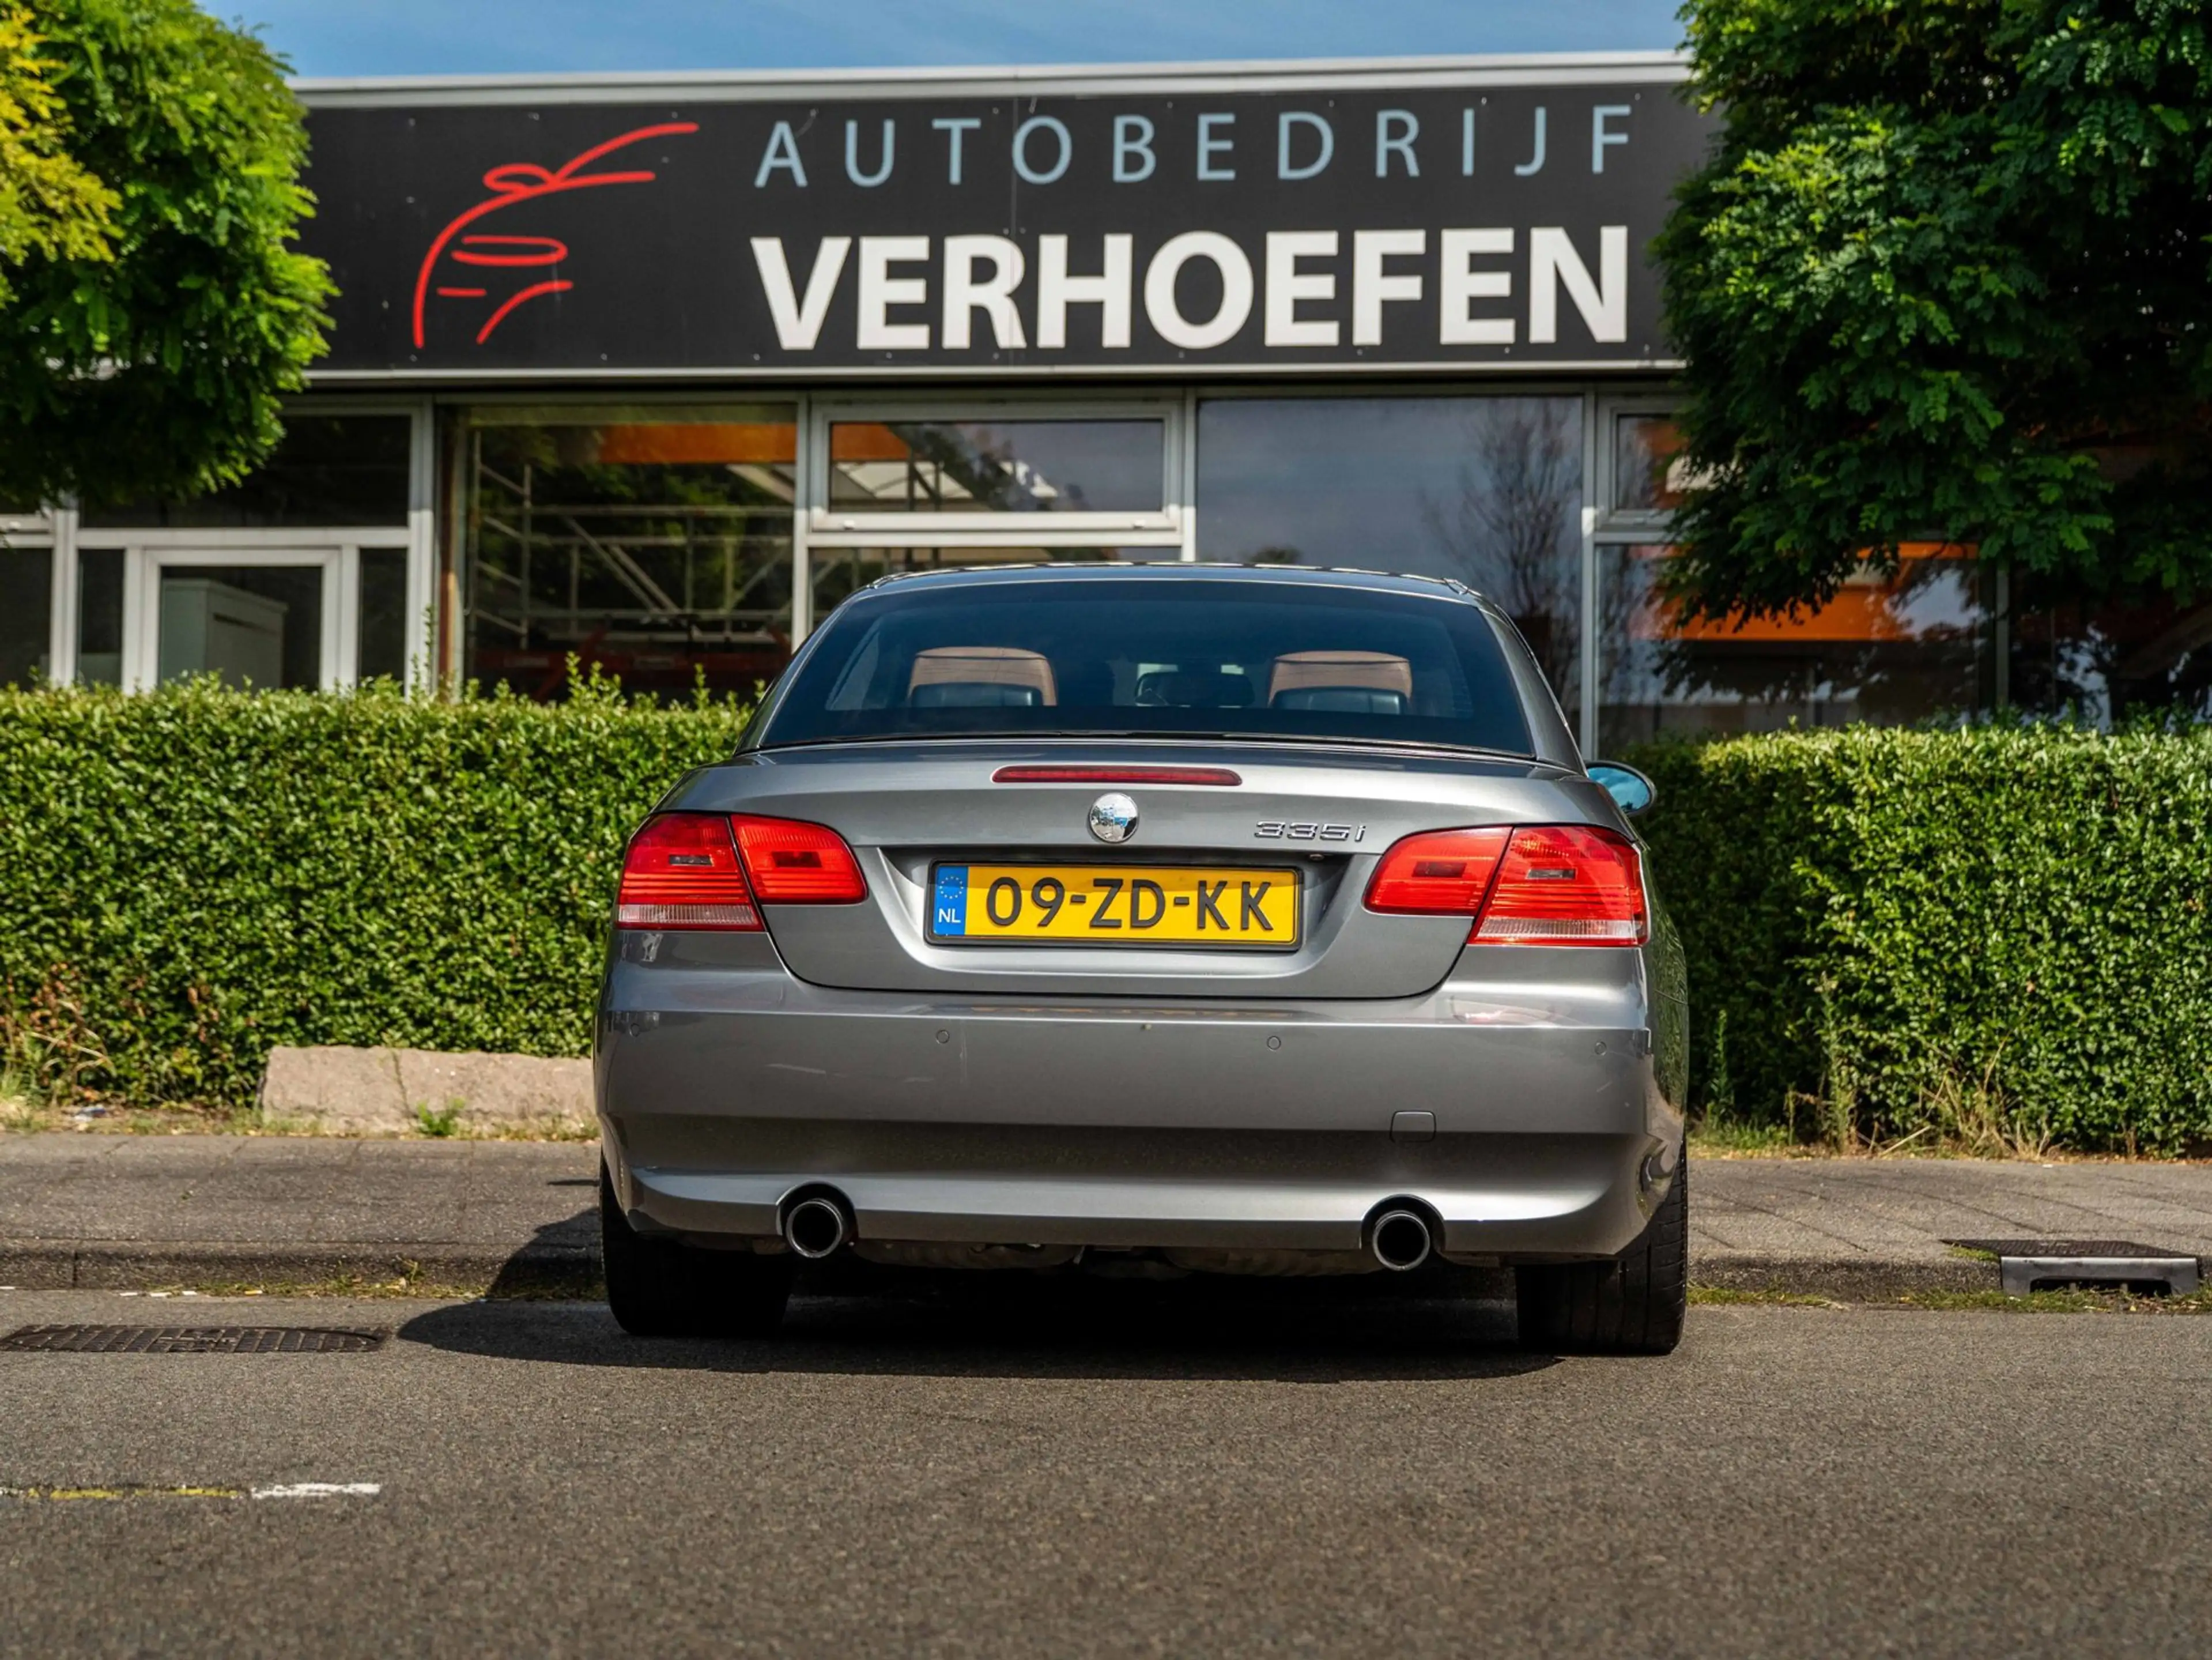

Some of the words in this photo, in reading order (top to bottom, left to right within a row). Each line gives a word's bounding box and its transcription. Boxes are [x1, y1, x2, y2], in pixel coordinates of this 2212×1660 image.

[754, 105, 1632, 188] AUTOBEDRIJF
[750, 225, 1628, 350] VERHOEFEN
[1255, 821, 1366, 842] 335i
[938, 908, 961, 923] NL
[986, 876, 1274, 931] 09-ZD-KK
